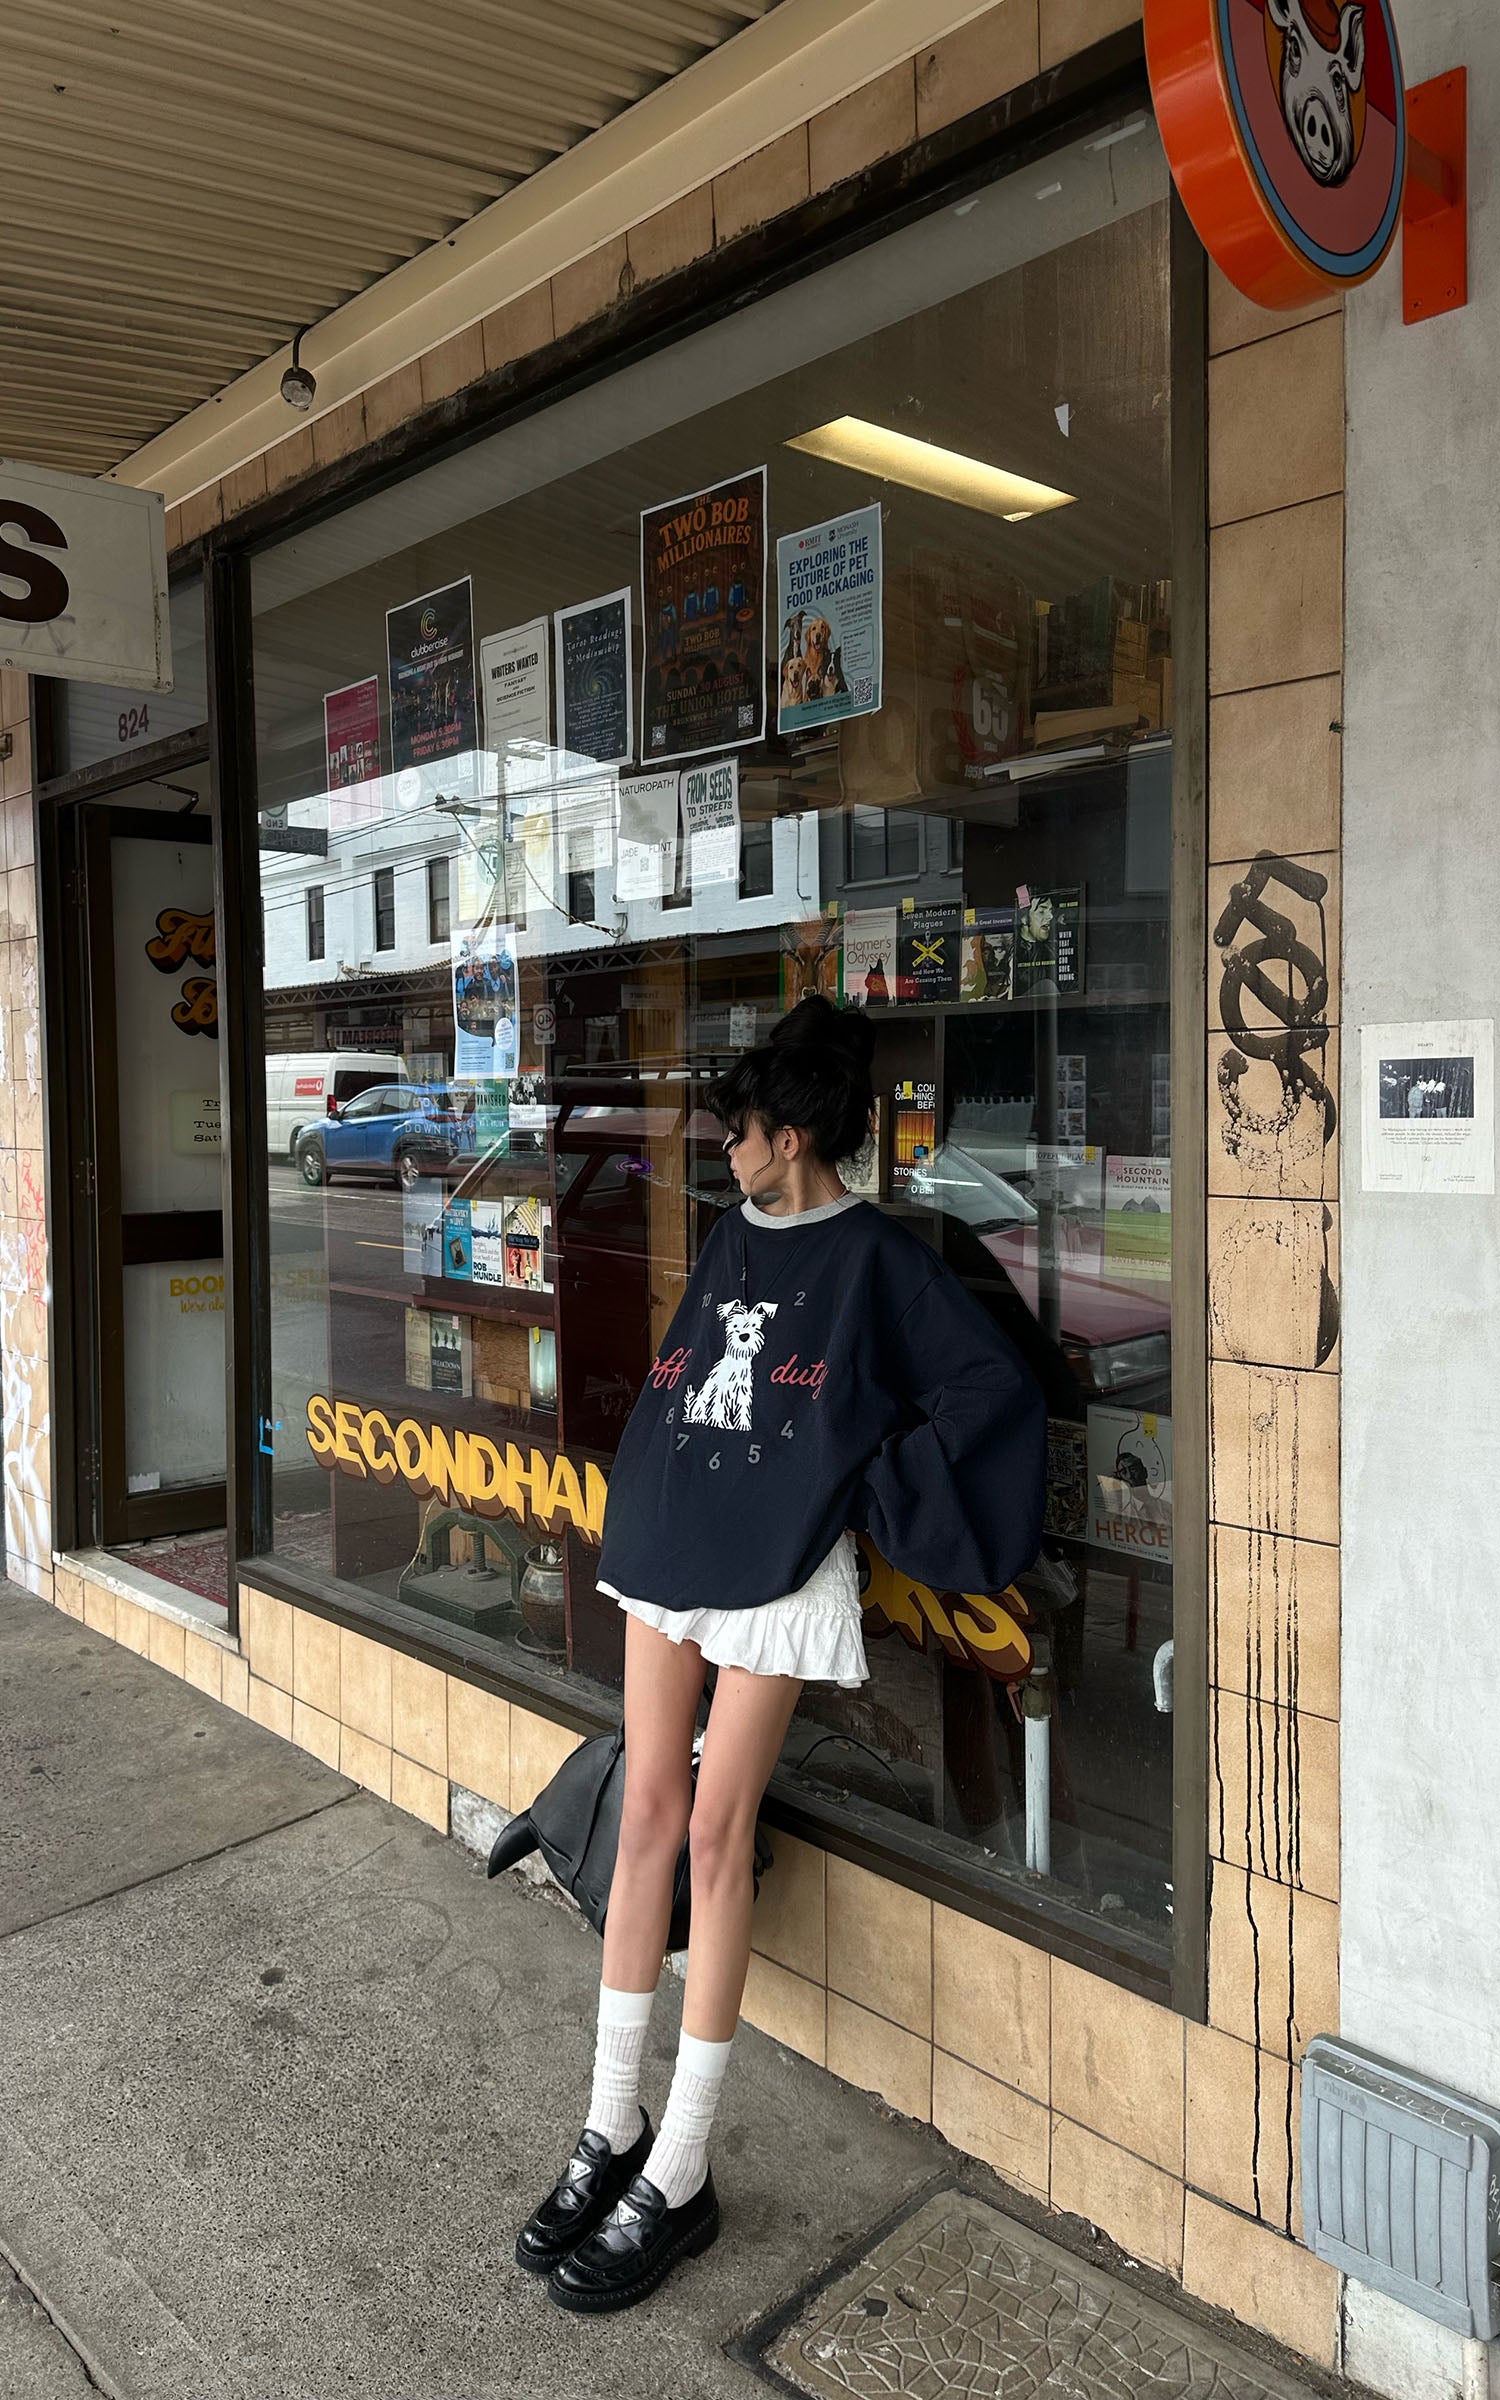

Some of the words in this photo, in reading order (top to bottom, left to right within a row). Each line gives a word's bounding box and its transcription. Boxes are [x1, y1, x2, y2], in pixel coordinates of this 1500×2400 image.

[658, 507, 707, 549] TWO
[711, 498, 750, 527] BOB
[657, 525, 752, 573] MILLIONAIRES
[789, 544, 847, 577] EXPLORING
[848, 536, 869, 554] THE
[790, 568, 831, 592] FUTURE
[832, 562, 846, 577] OF
[849, 553, 869, 572] PET
[786, 588, 813, 610] FOOD
[815, 568, 874, 601] PACKAGING
[411, 637, 449, 659] clubbercise
[491, 660, 516, 681] WRITERS
[516, 652, 539, 672] WANTED
[655, 703, 677, 719] THE
[681, 695, 714, 714] UNION
[717, 685, 752, 703] HOTEL
[666, 685, 698, 702] SUNDAY
[118, 704, 149, 742] 824
[410, 731, 437, 745] MONDAY
[413, 743, 435, 758] FRIDAY
[620, 778, 674, 797] NATUROPATH
[686, 772, 707, 805] FROM
[709, 766, 733, 802] SEEDS
[687, 806, 697, 818] TO
[699, 801, 733, 816] STREETS
[902, 911, 924, 921] Seven
[925, 908, 957, 918] Modern
[913, 920, 944, 930] Plagues
[846, 936, 892, 952] Homer's
[846, 951, 892, 967] Odyssey
[893, 1166, 928, 1178] STORIES
[1116, 1175, 1169, 1185] MOUNTAIN
[1123, 1167, 1163, 1176] SECOND
[473, 1261, 487, 1272] ROB
[473, 1271, 502, 1282] MUNDLE
[702, 1292, 712, 1308] 10
[793, 1290, 806, 1306] 2
[648, 1347, 693, 1391] off
[769, 1353, 829, 1400] duty
[665, 1407, 675, 1424] 8
[780, 1419, 794, 1440] 4
[675, 1433, 690, 1451] 7
[708, 1451, 721, 1470] 6
[747, 1444, 762, 1464] 5
